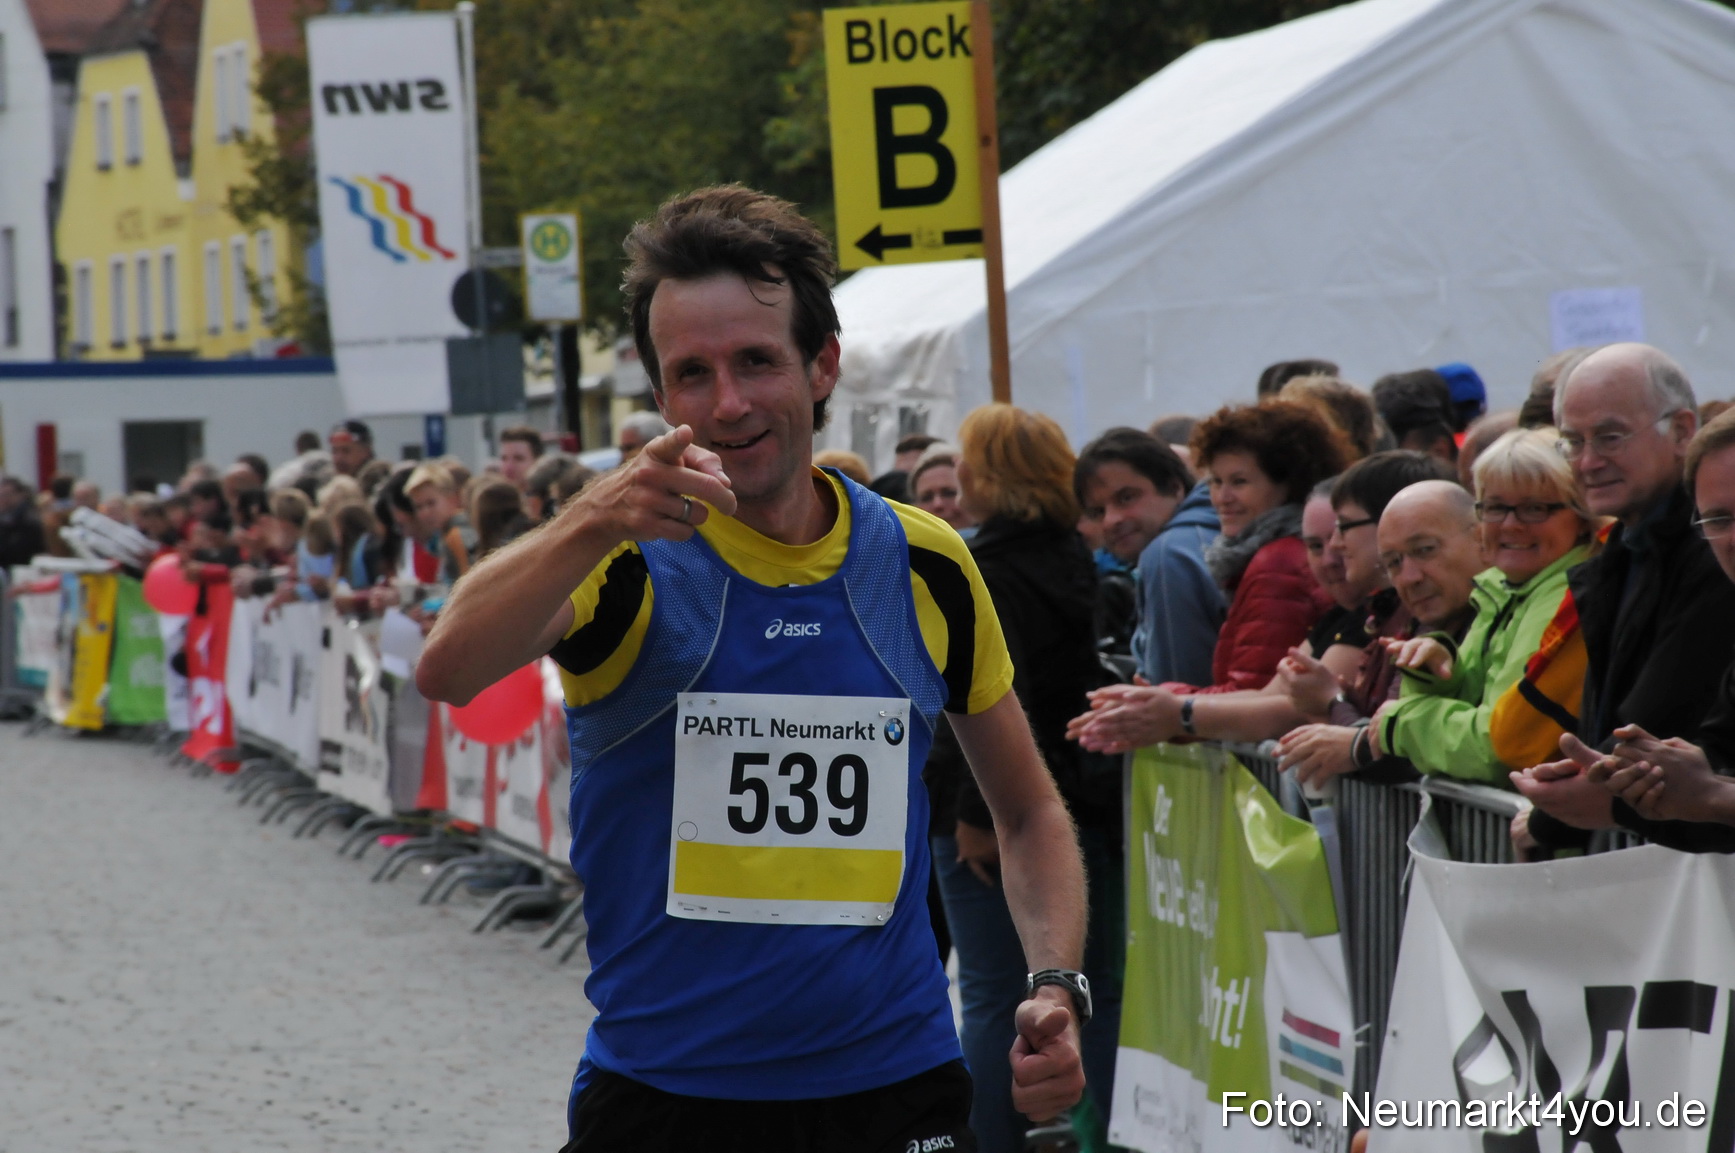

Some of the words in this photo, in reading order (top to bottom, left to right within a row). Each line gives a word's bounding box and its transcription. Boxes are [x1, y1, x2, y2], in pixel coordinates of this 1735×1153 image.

[844, 14, 973, 65] Block
[872, 84, 957, 211] B
[783, 623, 821, 636] asics
[683, 715, 764, 738] PARTL
[770, 718, 875, 741] Neumarkt
[727, 752, 869, 837] 539
[922, 1135, 954, 1152] asics
